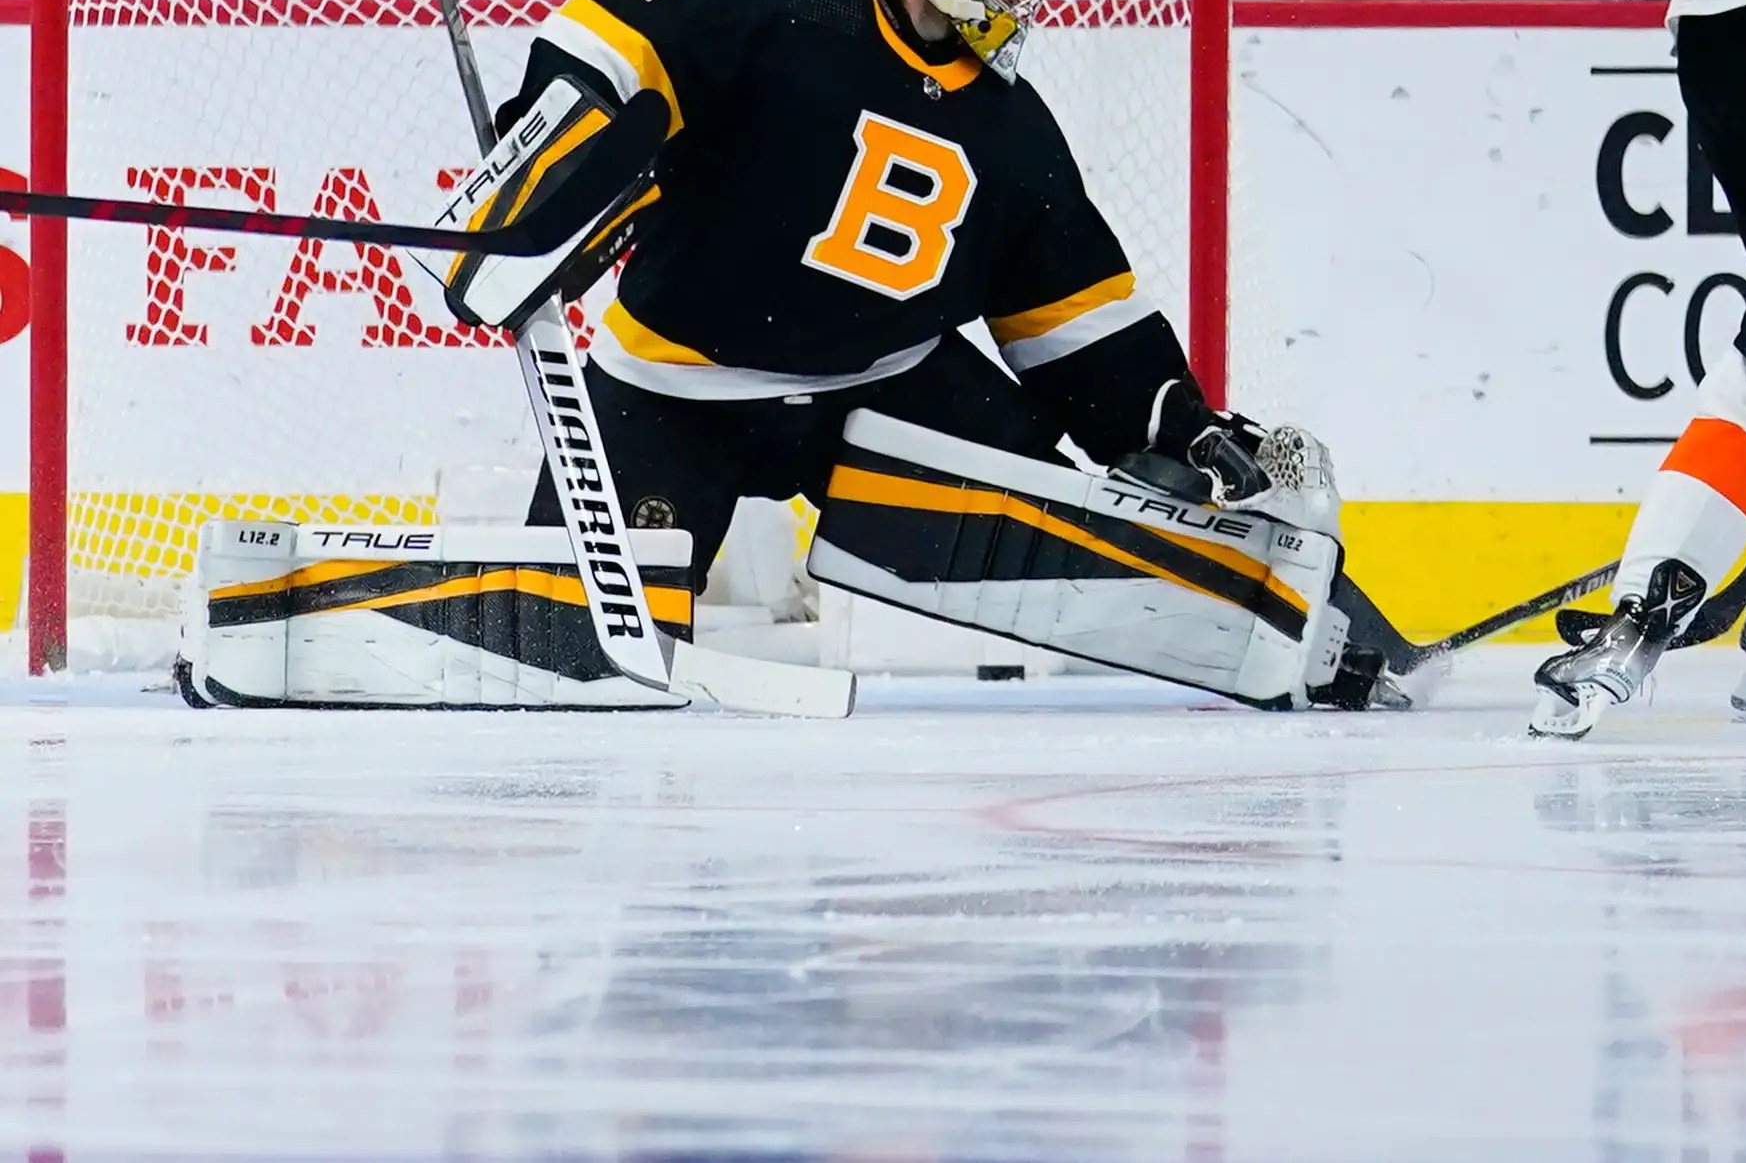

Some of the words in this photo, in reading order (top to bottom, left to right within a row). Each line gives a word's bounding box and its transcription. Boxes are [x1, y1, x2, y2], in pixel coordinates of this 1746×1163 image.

[434, 110, 548, 228] TRUE
[801, 108, 979, 302] B
[530, 348, 644, 639] WARRIOR
[1102, 486, 1253, 541] TRUE
[238, 529, 280, 547] L12.2
[312, 529, 435, 551] TRUE
[1277, 532, 1304, 552] L12.2
